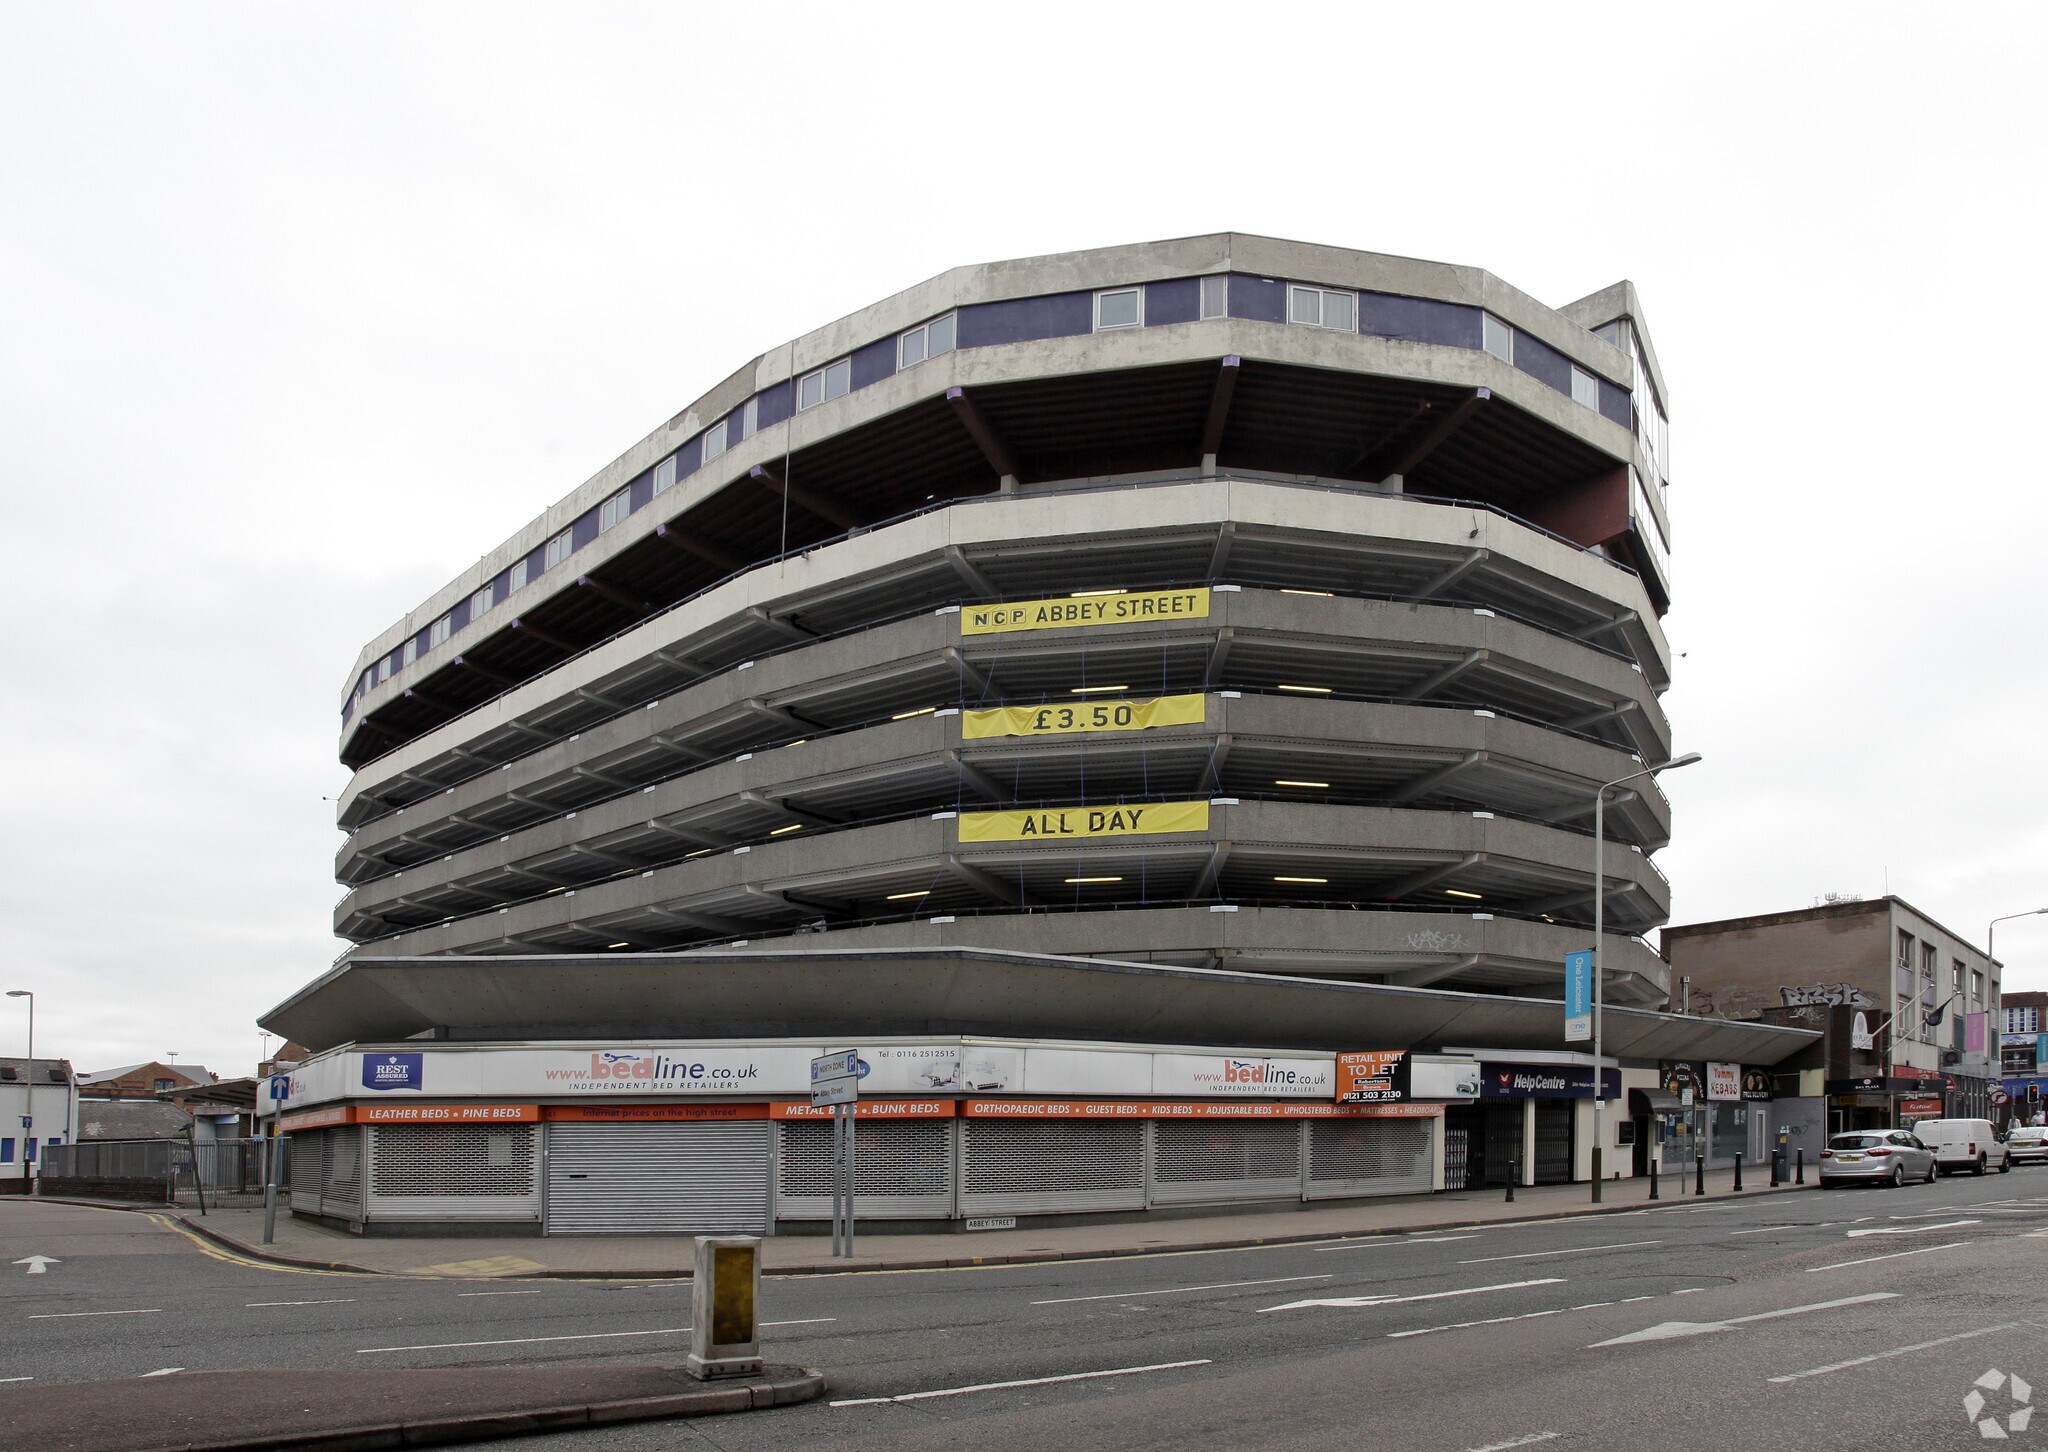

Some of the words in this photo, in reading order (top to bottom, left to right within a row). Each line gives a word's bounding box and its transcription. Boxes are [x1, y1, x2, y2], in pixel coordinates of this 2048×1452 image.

[974, 610, 1025, 626] NCP
[1036, 602, 1107, 623] ABBEY
[1116, 595, 1197, 616] STREET
[1033, 705, 1132, 730] £3.50
[1021, 813, 1074, 835] ALL
[1089, 809, 1143, 832] DAY
[920, 1050, 955, 1058] 2512515
[1341, 1054, 1376, 1063] RETAIL
[1379, 1053, 1404, 1062] UNIT
[376, 1065, 409, 1074] REST
[546, 1053, 759, 1080] www.bedline.co.uk
[820, 1064, 832, 1073] NORTH
[832, 1061, 845, 1070] ZONE
[1193, 1059, 1326, 1085] www.bedline.co.uk
[1347, 1064, 1367, 1076] TO
[1371, 1063, 1398, 1075] LET
[1713, 1067, 1734, 1081] Yummy
[569, 1082, 647, 1090] INDEPENDENT
[680, 1081, 739, 1089] RETAILERS
[831, 1087, 843, 1095] Street
[1711, 1083, 1738, 1097] KEBABS
[1343, 1092, 1360, 1100] 0121
[1362, 1091, 1379, 1099] 503
[1382, 1090, 1402, 1098] 2130
[369, 1109, 418, 1119] LEATHER
[421, 1108, 450, 1118] BEDS
[462, 1108, 489, 1118] PINE
[492, 1108, 522, 1118] BEDS
[583, 1109, 619, 1117] Internet
[623, 1109, 650, 1118] prices
[668, 1108, 683, 1116] the
[686, 1108, 708, 1117] high
[710, 1108, 737, 1116] street
[786, 1105, 825, 1115] METAL
[872, 1104, 906, 1114] BUNK
[909, 1104, 940, 1114] BEDS
[974, 1103, 1044, 1114] ORTHOPAEDIC
[1047, 1104, 1070, 1114] BEDS
[1085, 1105, 1114, 1114] GUEST
[1116, 1105, 1138, 1114] BEDS
[1151, 1105, 1171, 1114] KIDS
[1172, 1105, 1193, 1115] BEDS
[1206, 1106, 1253, 1115] ADJUSTABLE
[1254, 1106, 1272, 1115] BEDS
[1284, 1106, 1332, 1115] UPHOLSTERED
[1333, 1106, 1350, 1115] BEDS
[1360, 1106, 1398, 1115] MATTRESSES
[1404, 1106, 1444, 1115] HEADBOARDS
[969, 1220, 989, 1228] ABBEY
[991, 1218, 1014, 1227] STREET
